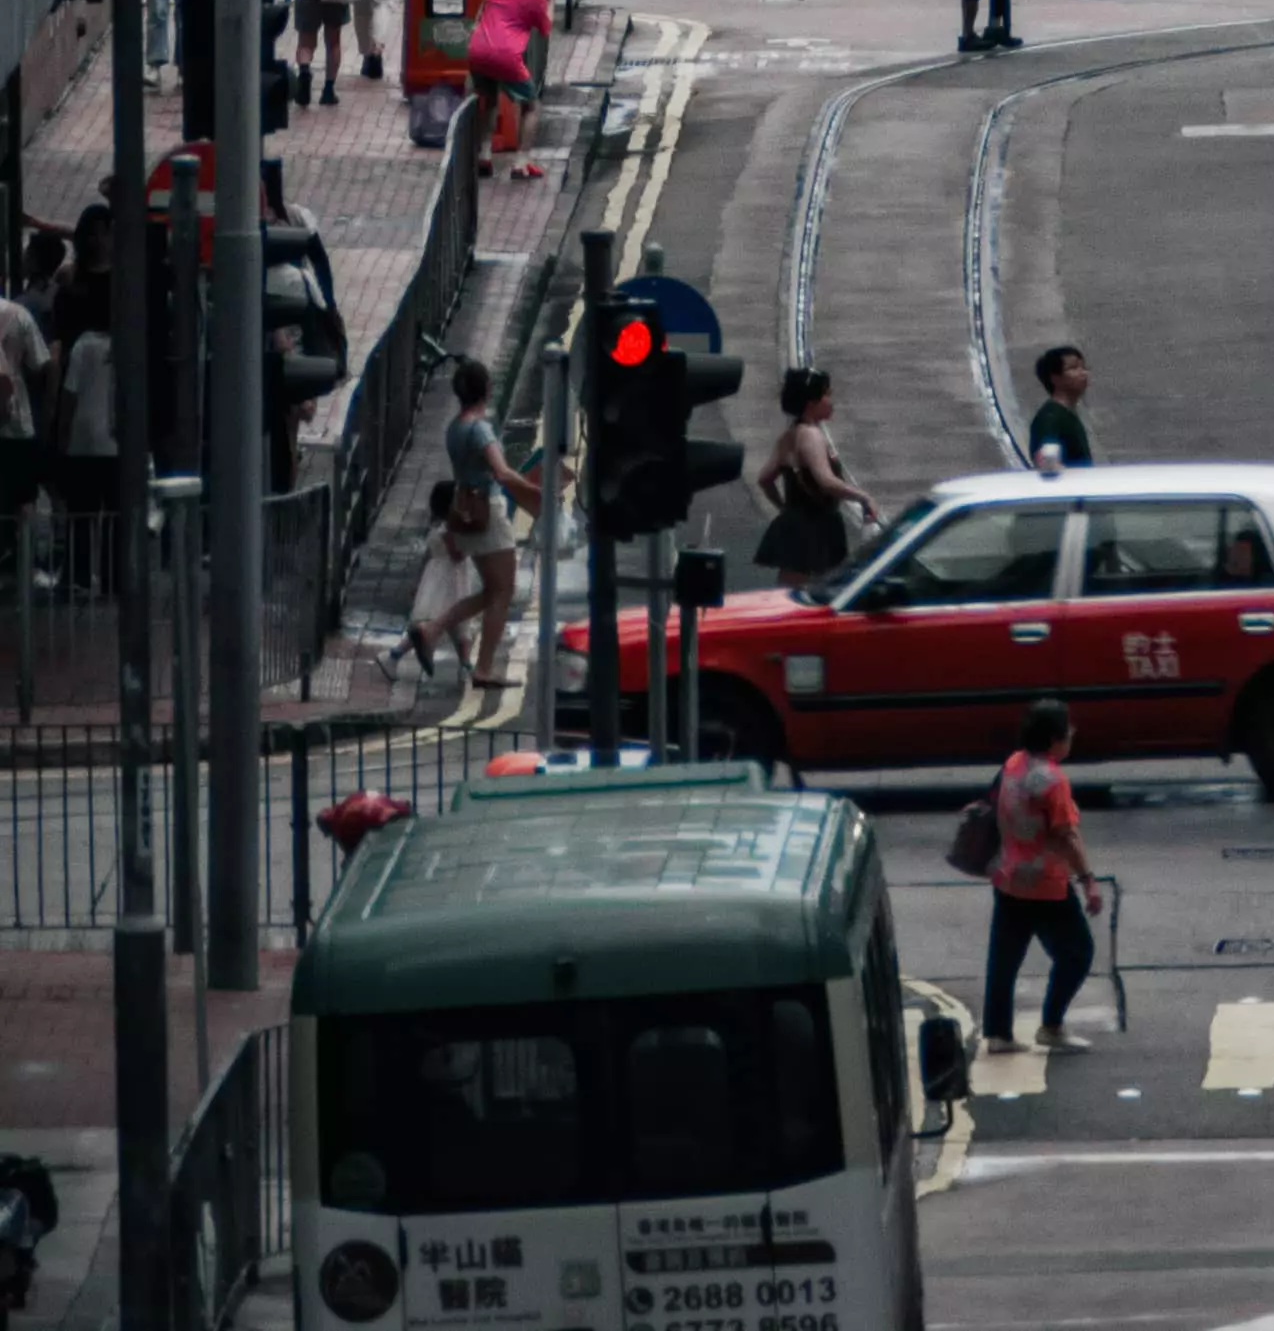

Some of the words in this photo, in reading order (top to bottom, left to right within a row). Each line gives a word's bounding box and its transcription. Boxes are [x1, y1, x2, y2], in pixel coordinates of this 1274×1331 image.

[1126, 655, 1180, 679] TAXI
[664, 1282, 743, 1312] 2688
[757, 1276, 837, 1307] 0013
